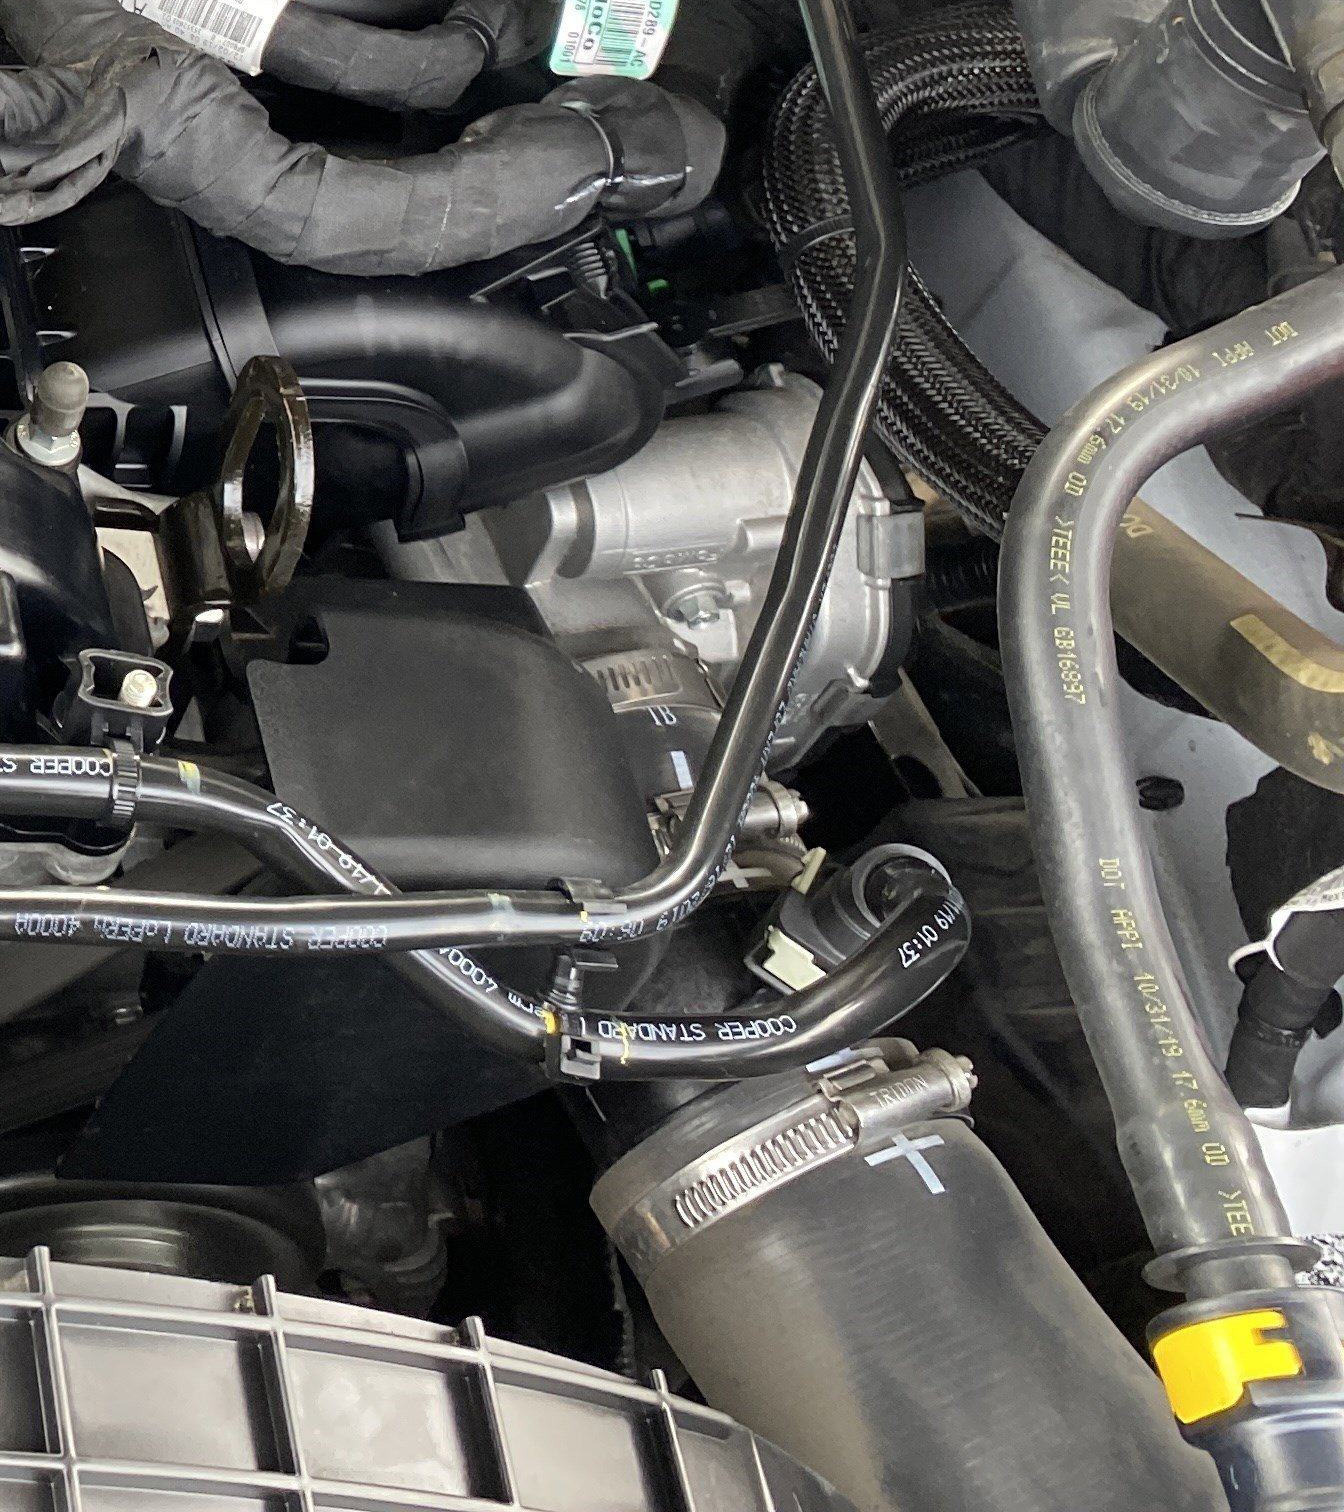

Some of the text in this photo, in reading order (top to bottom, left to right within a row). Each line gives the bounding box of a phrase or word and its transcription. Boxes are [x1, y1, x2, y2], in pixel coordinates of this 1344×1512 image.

[1064, 471, 1087, 496] OD
[1053, 626, 1086, 705] GB16897
[30, 755, 113, 777] COOPER
[183, 920, 295, 949] STANDARD
[897, 924, 939, 968] 01:37
[597, 1019, 707, 1042] STANDARD
[714, 1014, 797, 1041] COOPER
[869, 1074, 929, 1108] TRIDON
[1201, 1141, 1230, 1167] OD
